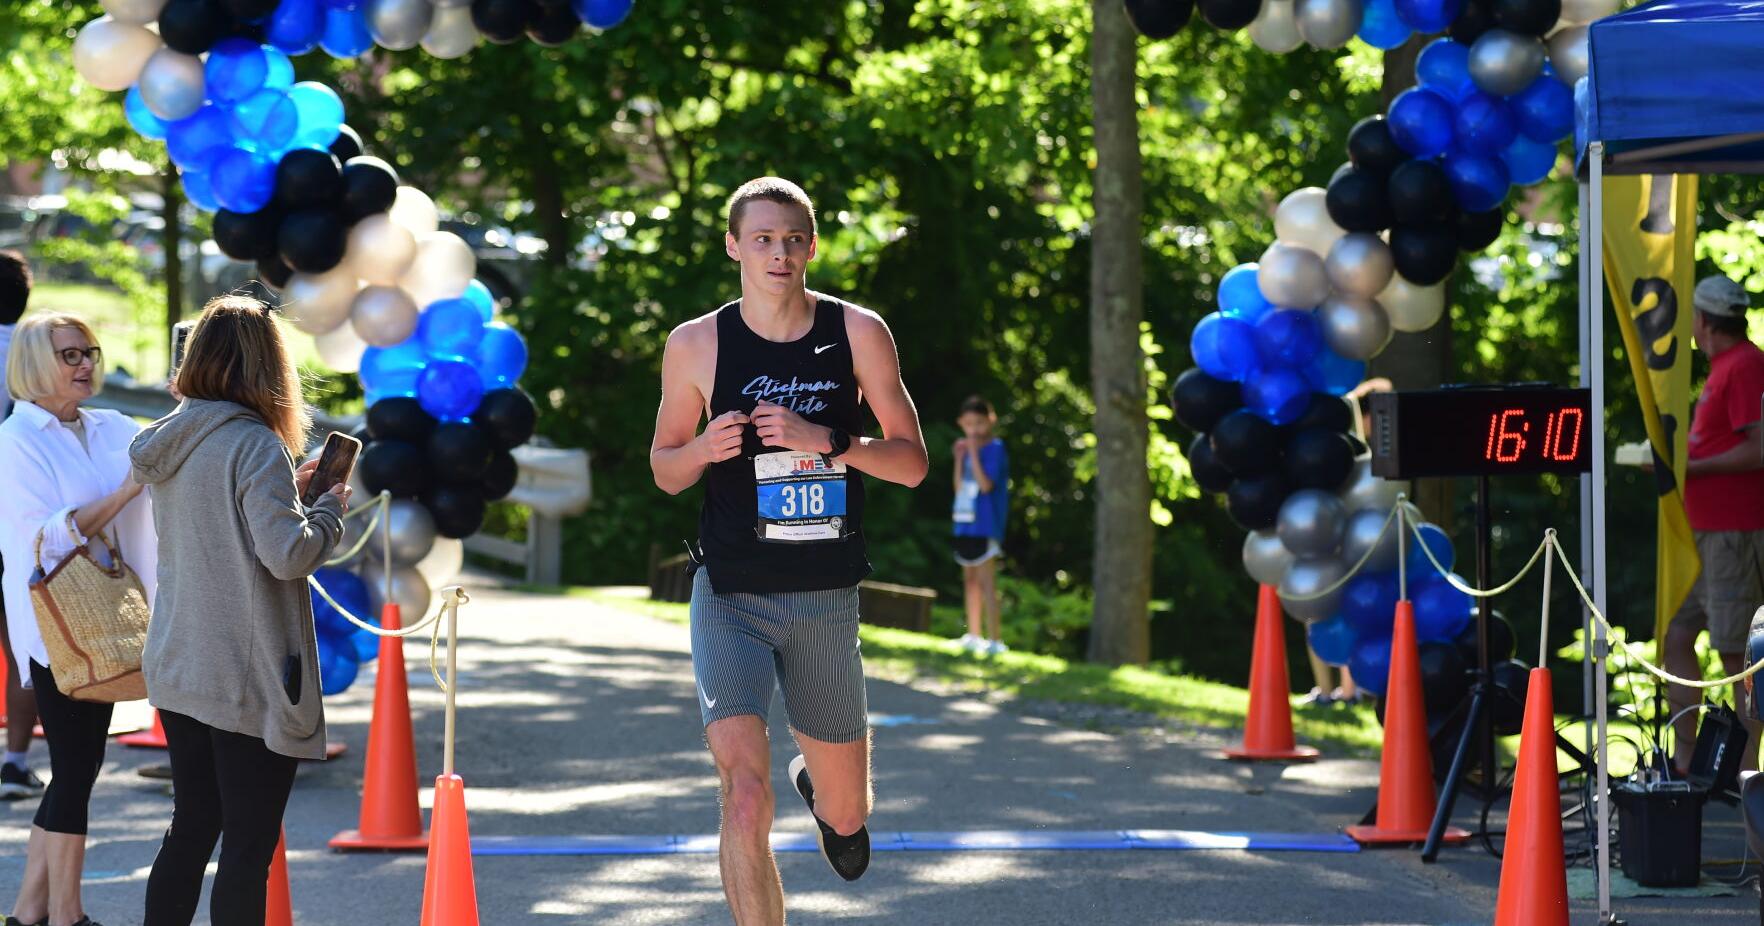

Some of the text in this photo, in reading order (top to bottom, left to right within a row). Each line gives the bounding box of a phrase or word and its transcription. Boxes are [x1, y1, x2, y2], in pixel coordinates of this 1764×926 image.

[742, 376, 840, 400] Stickman
[1486, 408, 1583, 462] 16:10
[782, 484, 824, 516] 318
